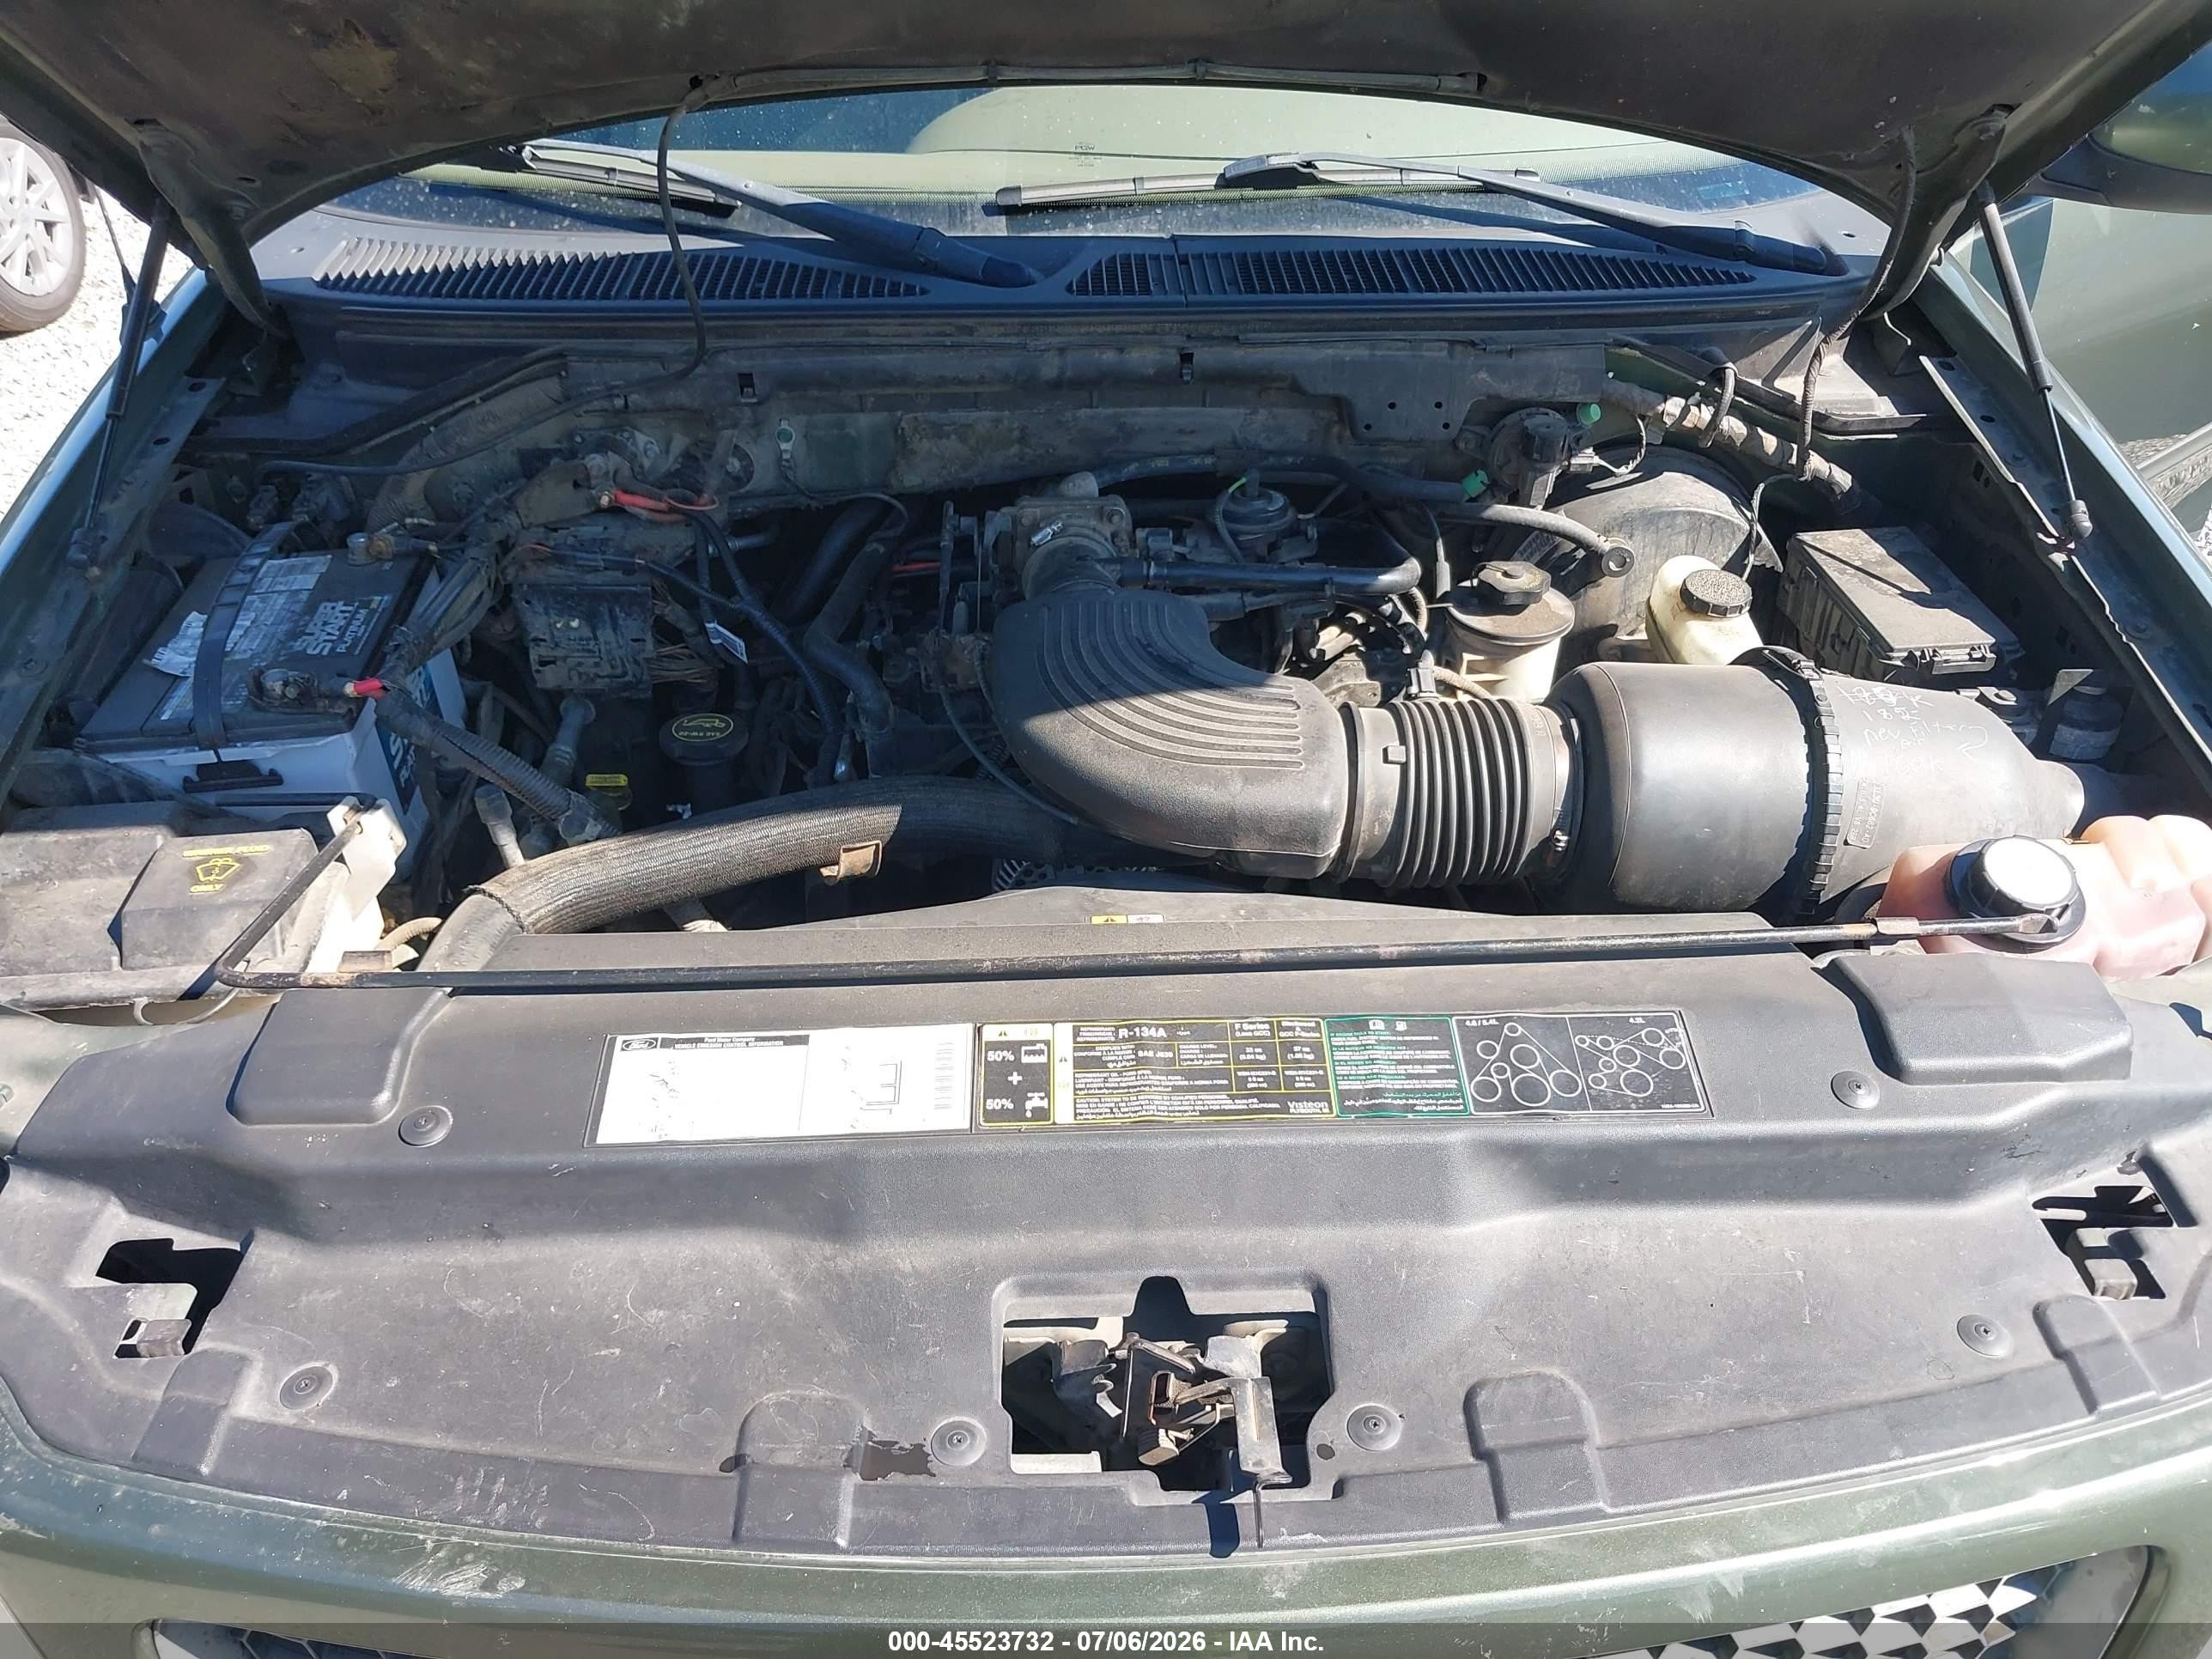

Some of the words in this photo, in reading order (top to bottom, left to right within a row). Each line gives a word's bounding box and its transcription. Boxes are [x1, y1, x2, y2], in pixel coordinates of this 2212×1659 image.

[292, 602, 337, 652] SUPER
[306, 600, 355, 655] START
[336, 609, 369, 653] PLATINUM
[1118, 1026, 1168, 1039] R-134A
[987, 1051, 1015, 1061] 50%
[986, 1098, 1014, 1110] 50%
